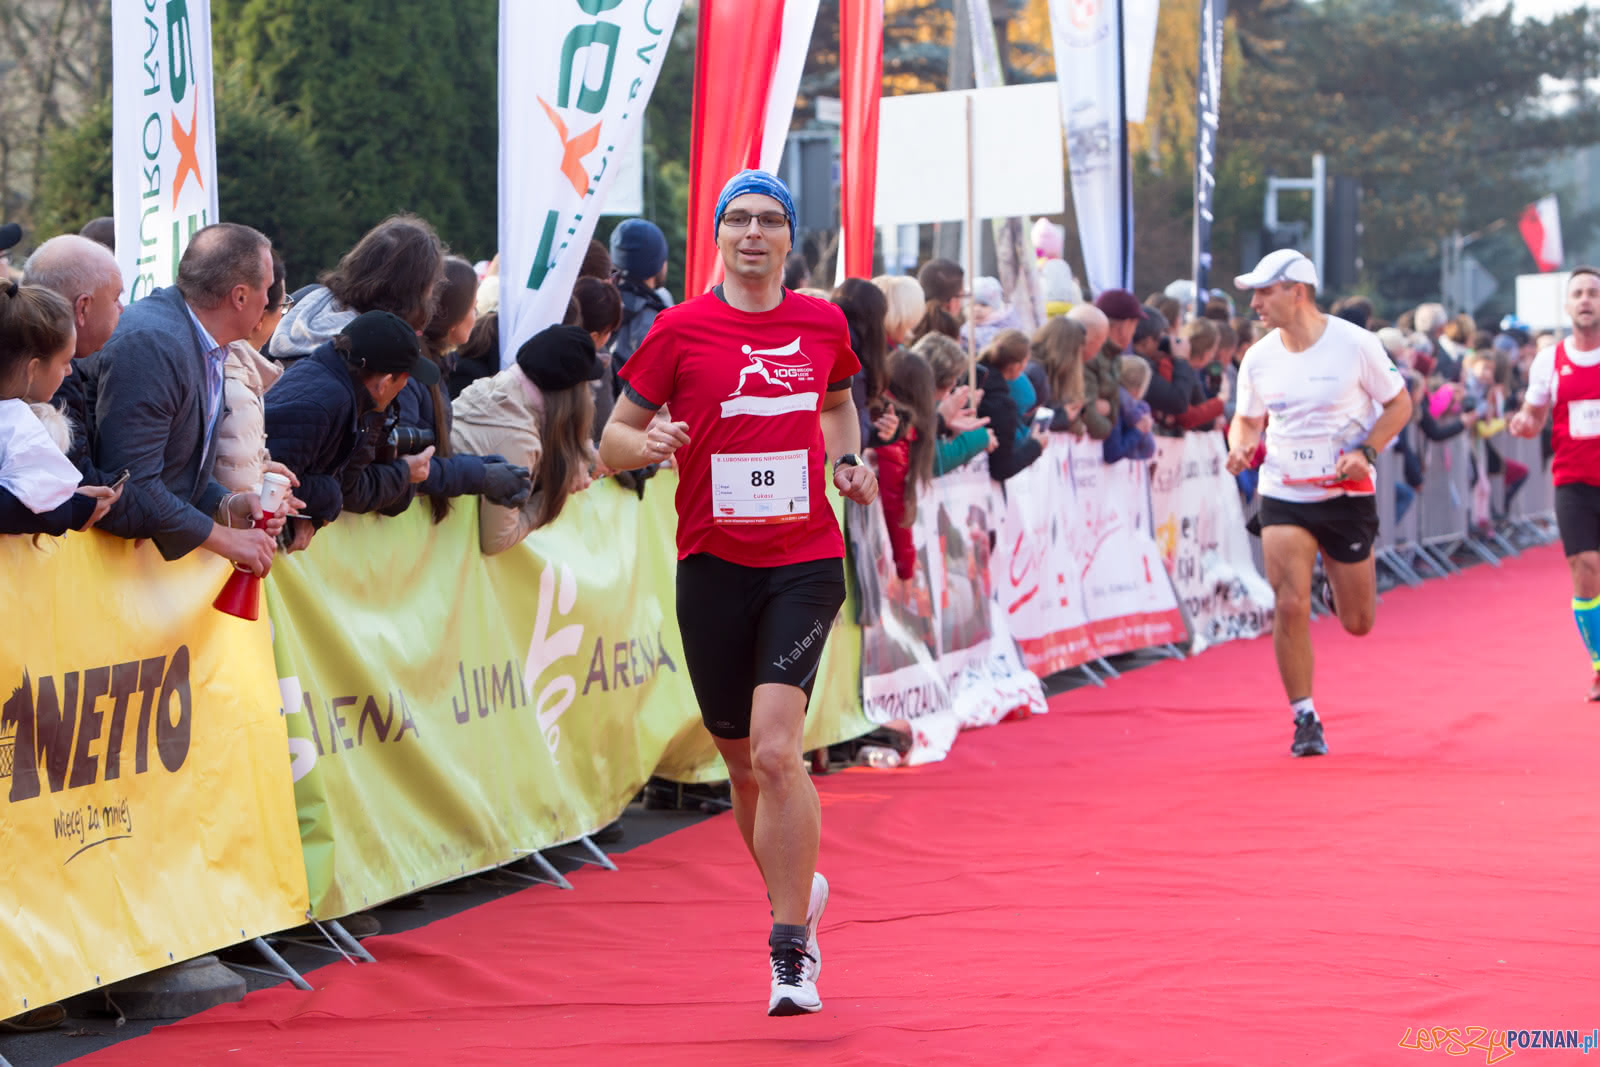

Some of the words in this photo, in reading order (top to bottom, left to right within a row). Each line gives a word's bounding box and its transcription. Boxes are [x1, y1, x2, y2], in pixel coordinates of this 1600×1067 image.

[1293, 449, 1314, 461] 762
[751, 470, 775, 487] 88
[773, 619, 823, 671] Kalenji
[36, 645, 192, 794] NETTO
